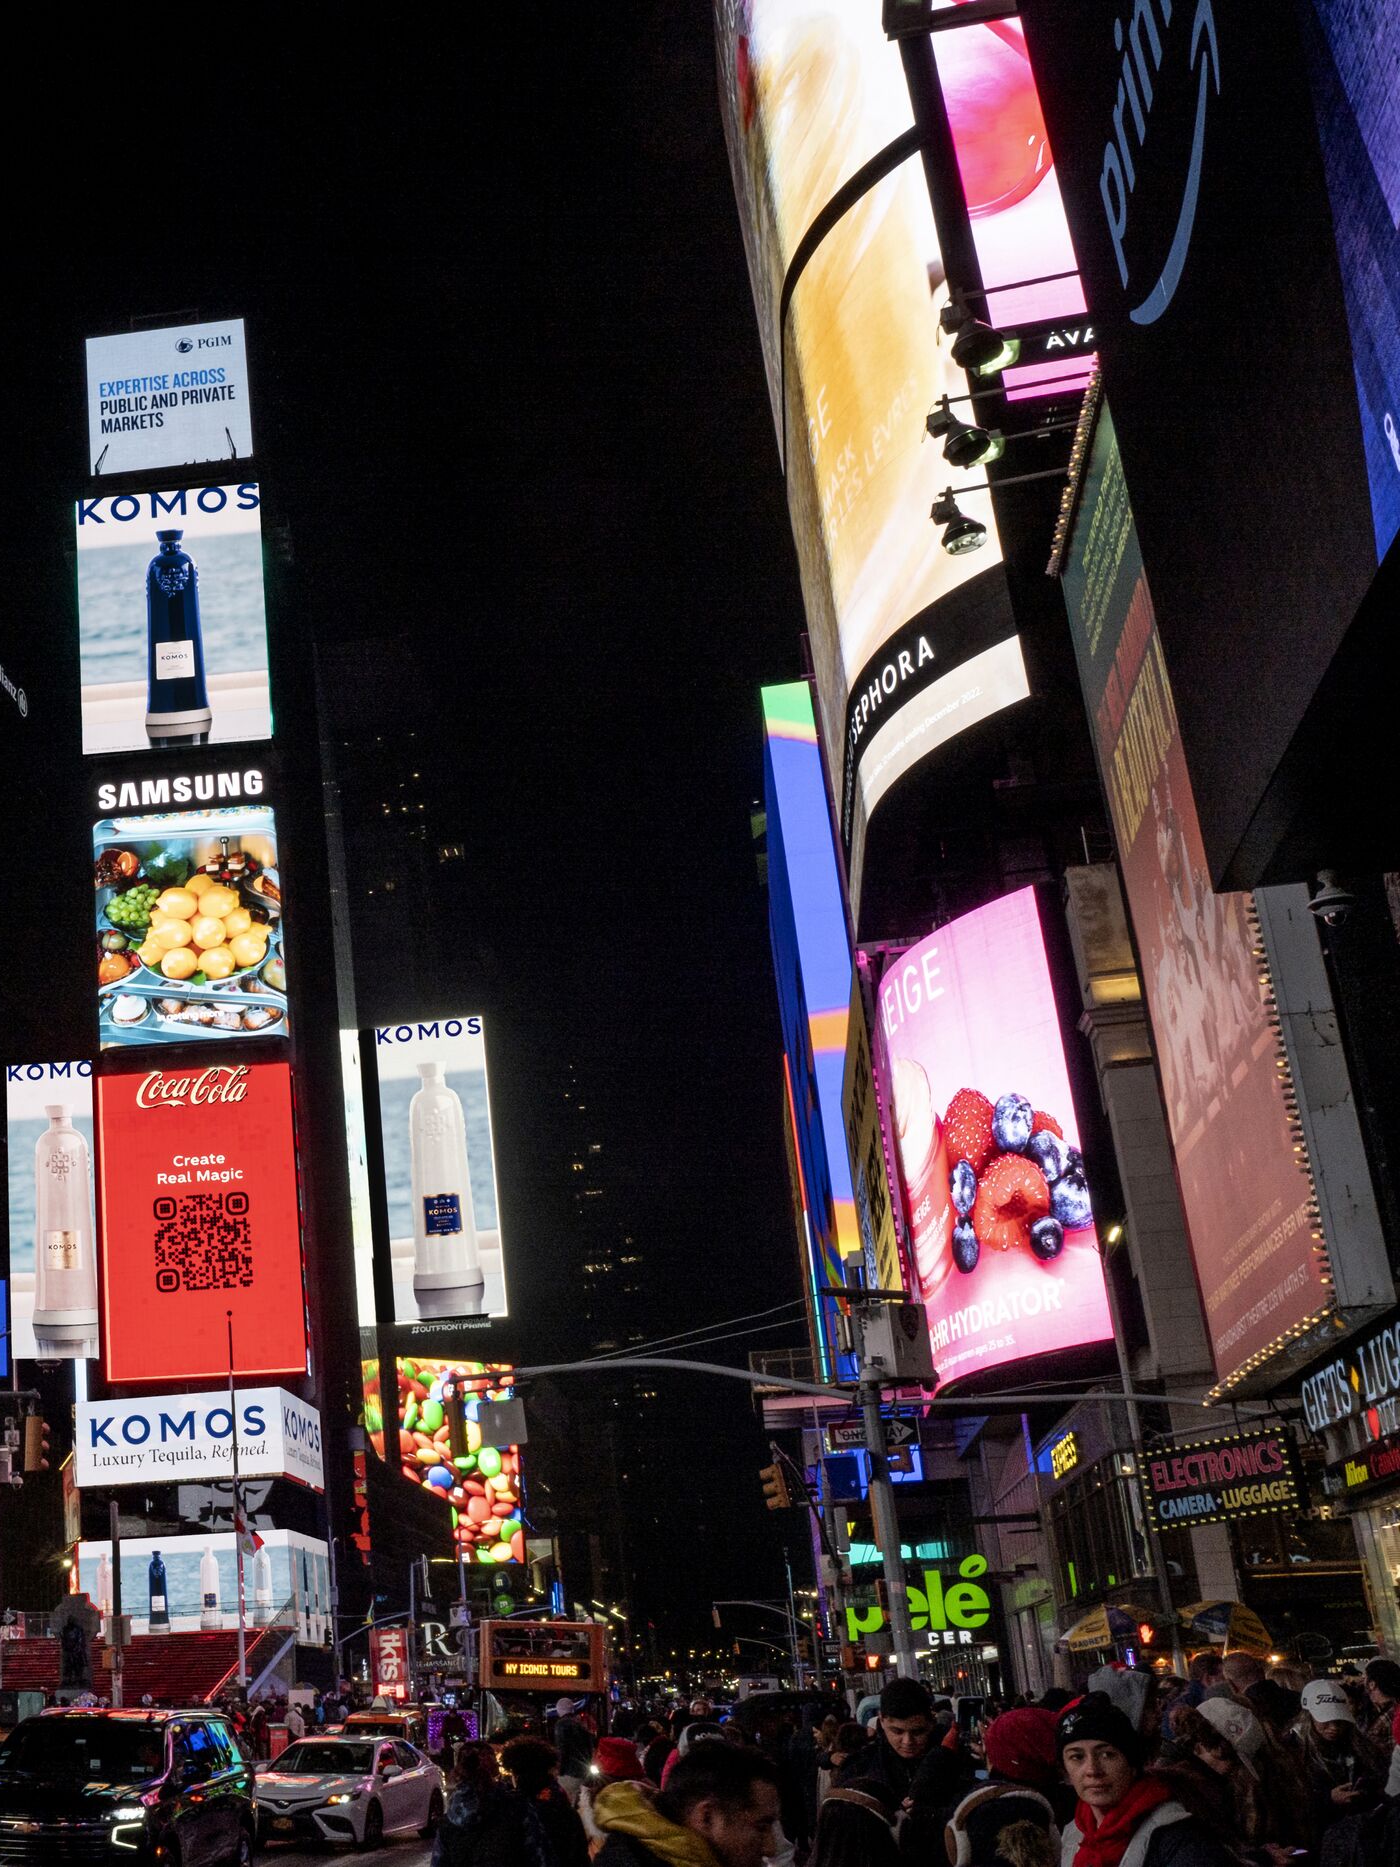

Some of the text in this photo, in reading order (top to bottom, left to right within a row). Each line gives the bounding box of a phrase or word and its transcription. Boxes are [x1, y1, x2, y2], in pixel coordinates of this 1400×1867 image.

[197, 335, 232, 350] PGIM
[99, 367, 226, 399] EXPERTISE ACROSS
[100, 385, 235, 416] PUBLIC AND PRIVATE
[101, 412, 164, 434] MARKETS
[77, 483, 260, 525] KOMOS
[161, 653, 188, 661] KOMOS
[851, 636, 935, 745] SEPHORA
[98, 769, 263, 810] SAMSUNG
[375, 1016, 482, 1046] KOMOS
[136, 1065, 251, 1109] Coca-Cola
[156, 1166, 245, 1185] Real Magic
[172, 1152, 226, 1168] Create
[428, 1207, 459, 1216] KOMOS
[1282, 1217, 1295, 1242] PER
[1302, 1358, 1352, 1433] GIFTS
[89, 1405, 266, 1447] KOMOS
[284, 1406, 320, 1452] KOMOS
[92, 1450, 145, 1468] Luxury
[148, 1446, 207, 1466] Tequila,
[211, 1440, 269, 1460] Refined.
[1150, 1440, 1284, 1492] ELECTRONICS
[1159, 1480, 1291, 1520] CAMERA LUGGAGE
[379, 1632, 402, 1681] tkts
[505, 1663, 578, 1677] NY ICONIC TOURS
